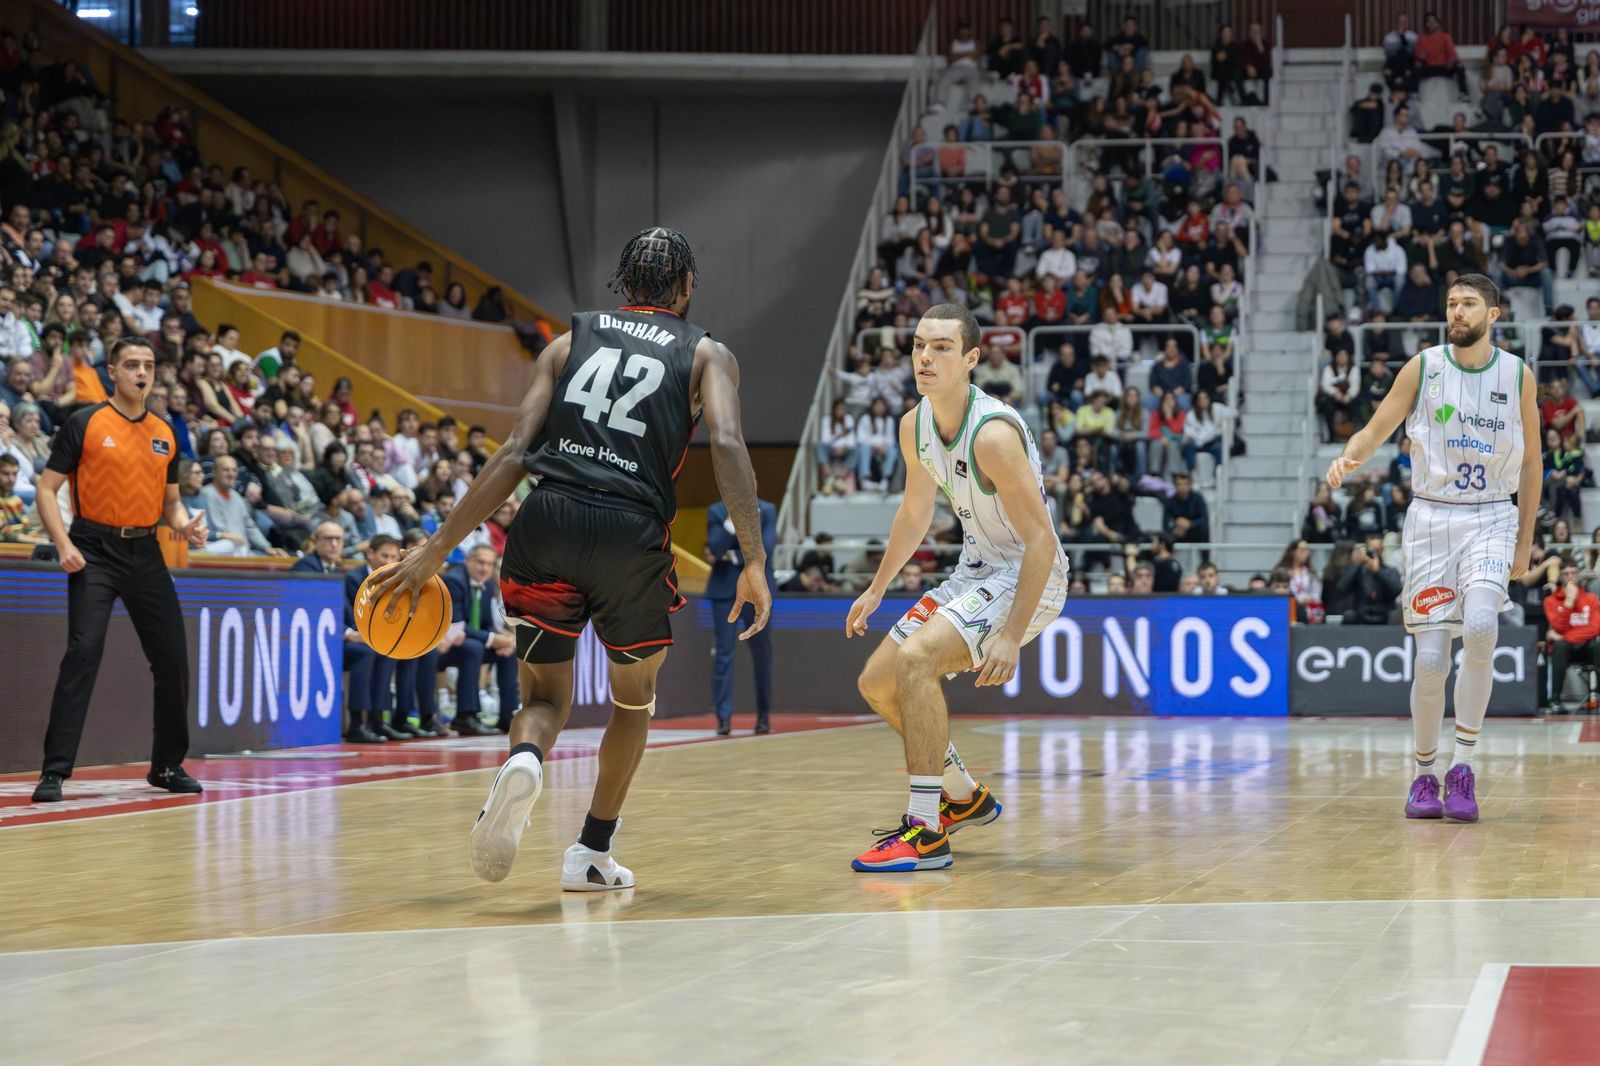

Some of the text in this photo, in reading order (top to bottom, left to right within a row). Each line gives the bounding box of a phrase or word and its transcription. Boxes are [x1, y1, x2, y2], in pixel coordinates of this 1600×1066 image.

[599, 314, 676, 347] DURHAM
[564, 346, 666, 438] 42
[1458, 411, 1506, 433] Unicaja
[558, 437, 638, 473] Kave Home
[1454, 462, 1487, 491] 33
[198, 607, 336, 728] IONOS
[1296, 635, 1525, 683] enda
